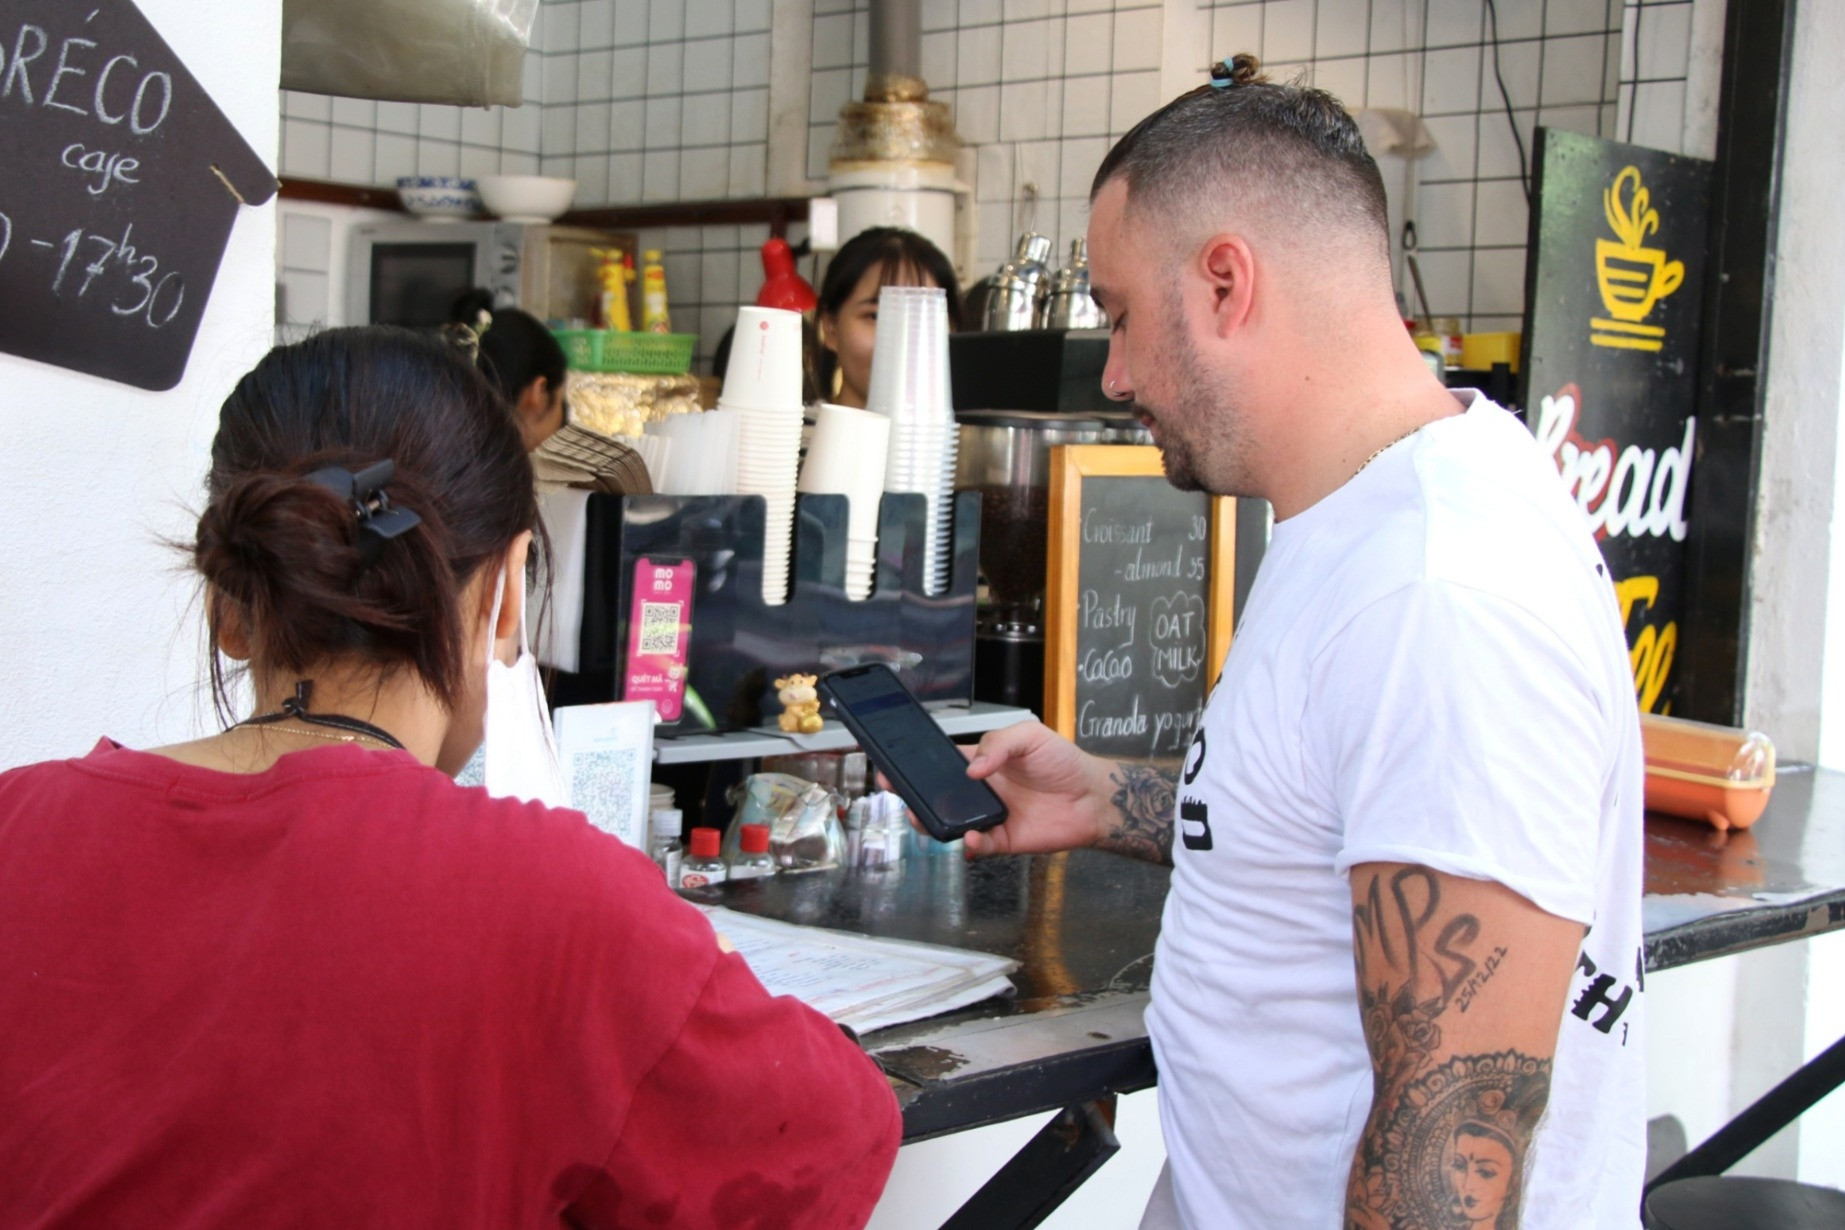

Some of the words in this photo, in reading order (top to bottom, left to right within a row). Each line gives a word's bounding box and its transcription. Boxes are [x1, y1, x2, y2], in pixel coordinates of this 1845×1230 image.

[0, 9, 172, 135] RÉCO
[1084, 507, 1154, 544] Croissant
[1188, 514, 1207, 541] 30
[1084, 589, 1136, 649] Pastry
[1156, 611, 1195, 640] OAT
[1080, 694, 1149, 738] Granola
